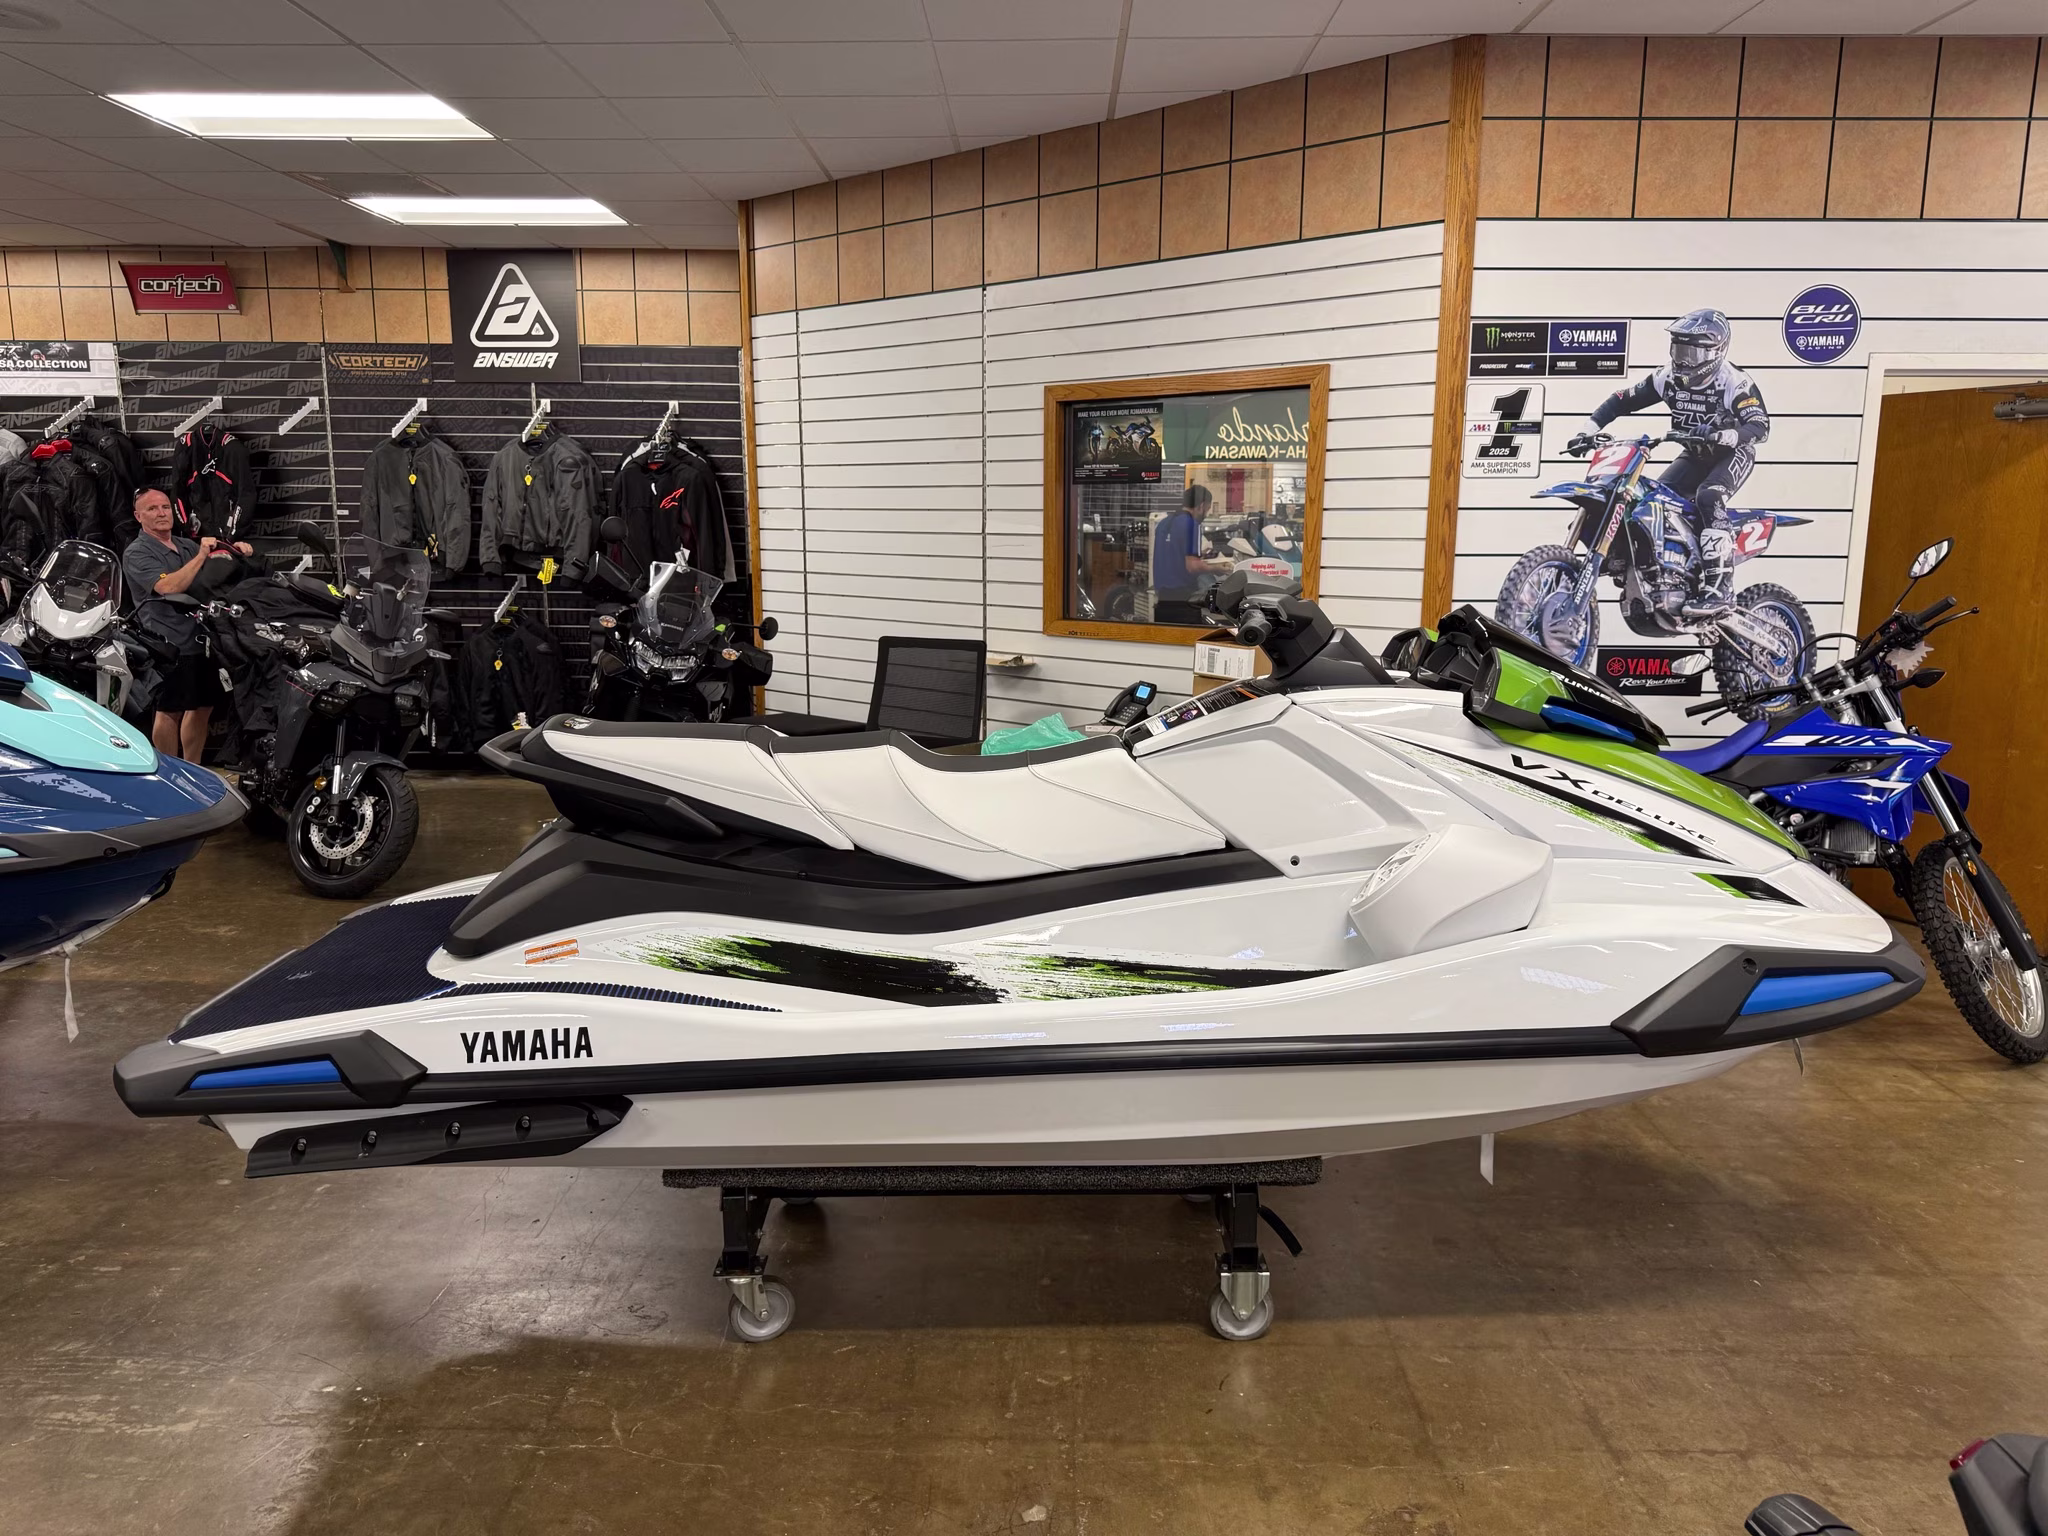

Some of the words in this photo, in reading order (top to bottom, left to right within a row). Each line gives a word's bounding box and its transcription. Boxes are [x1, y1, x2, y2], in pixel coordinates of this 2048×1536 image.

[140, 276, 221, 296] cortech
[1791, 304, 1850, 315] BLU
[1794, 314, 1854, 324] CRU
[1573, 330, 1617, 342] YAMAHA
[1807, 335, 1845, 346] YAMAHA
[16, 360, 88, 369] COLLECTION
[339, 356, 418, 368] CORTECH
[473, 352, 559, 369] ANSWER
[1591, 444, 1632, 476] 2
[1742, 522, 1768, 552] 2
[1627, 658, 1675, 676] YAMA
[1619, 678, 1646, 688] Revs
[1645, 679, 1664, 687] Your
[1510, 753, 1593, 791] VX
[1591, 789, 1717, 846] DELUXE
[460, 1026, 593, 1064] YAMAHA
